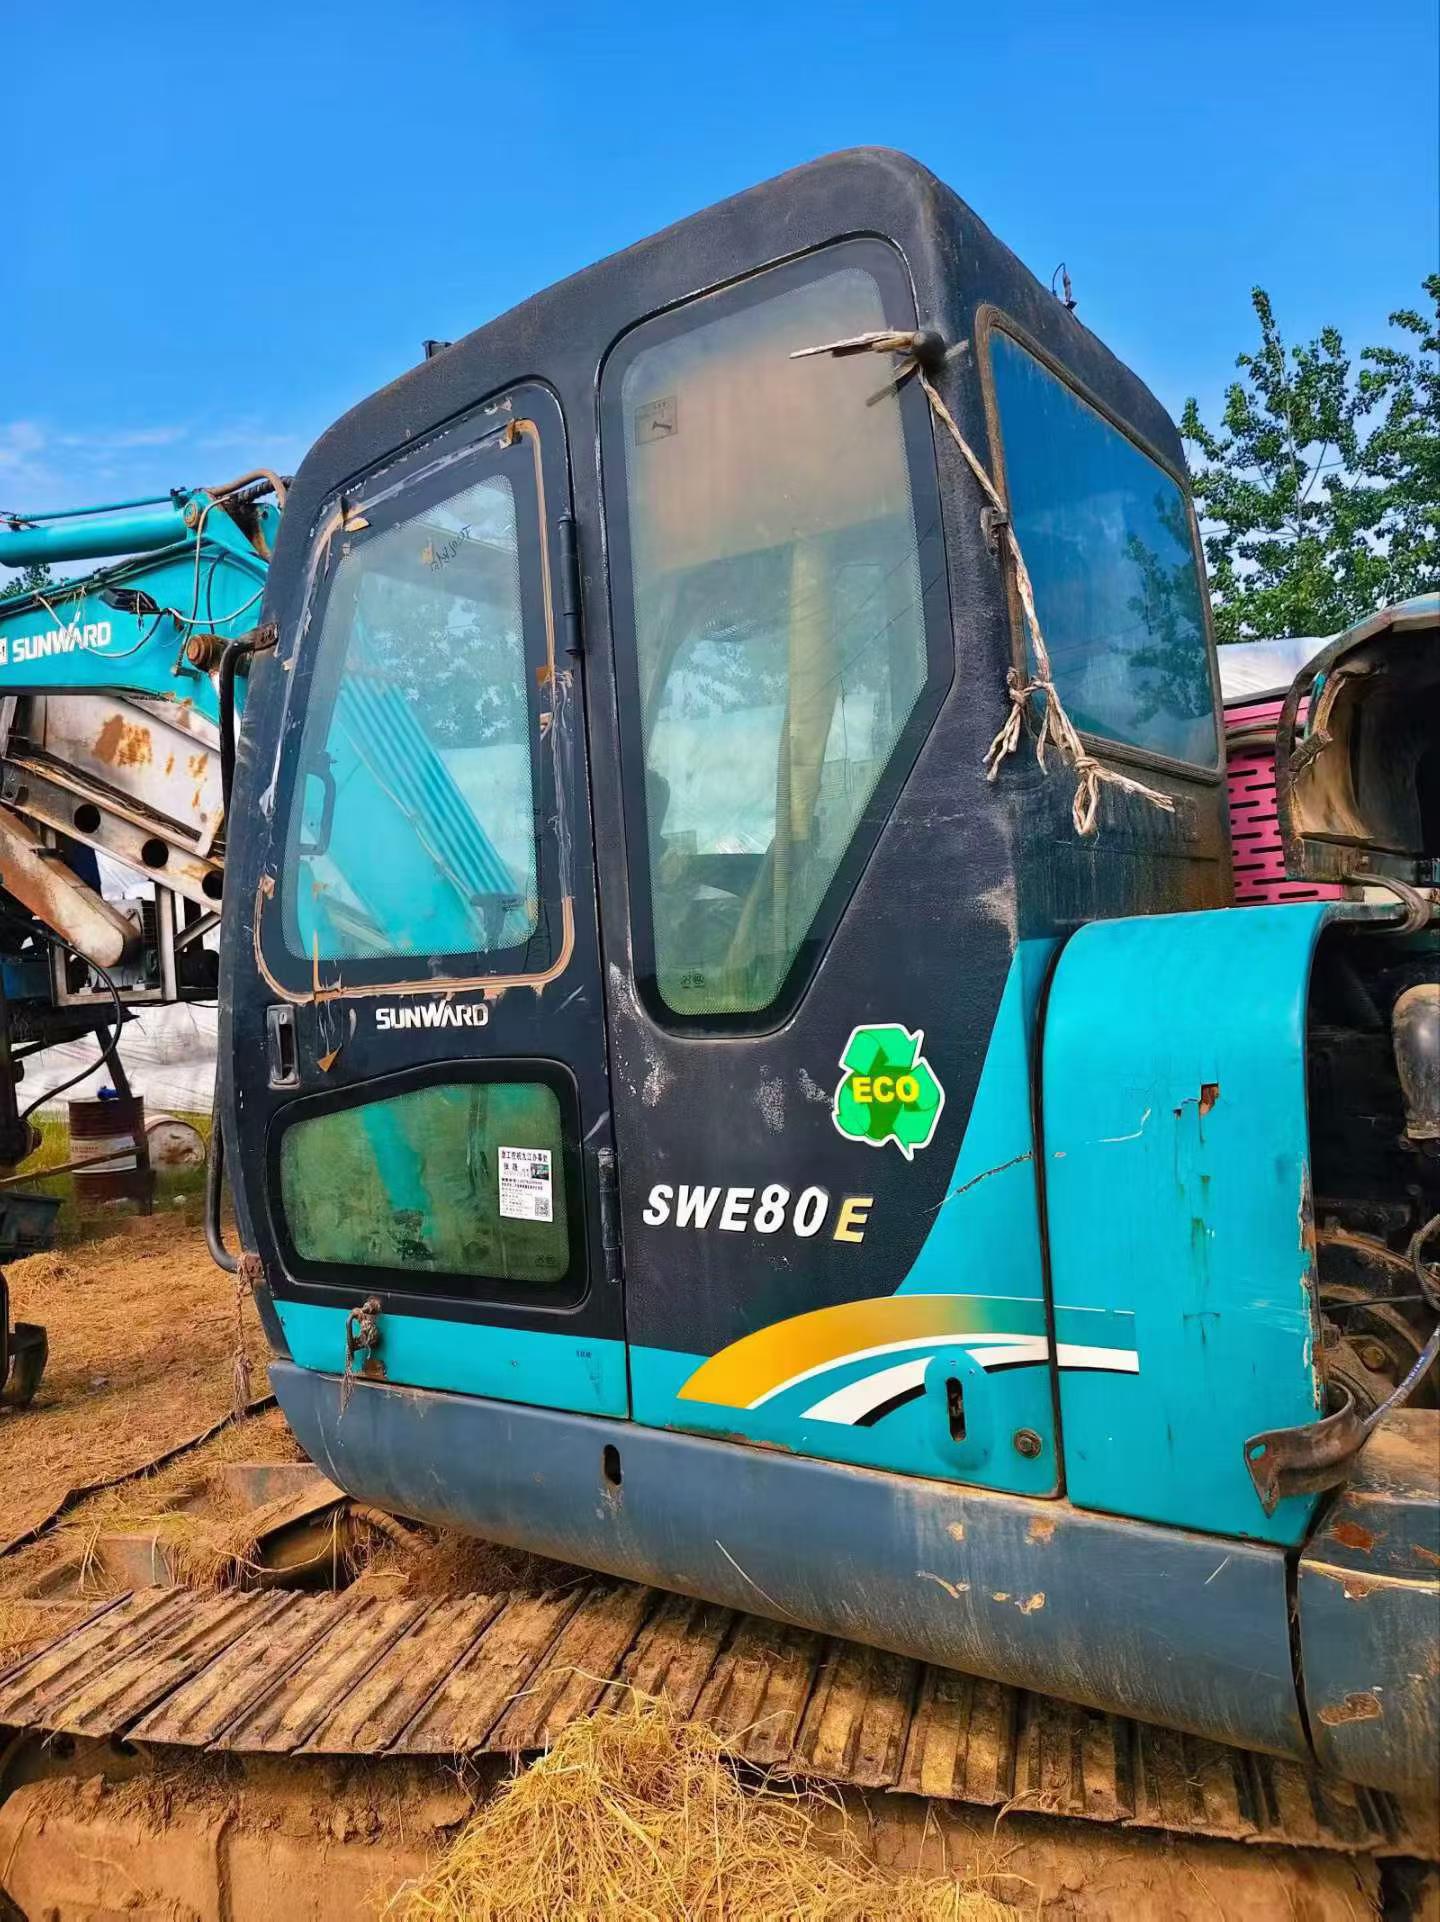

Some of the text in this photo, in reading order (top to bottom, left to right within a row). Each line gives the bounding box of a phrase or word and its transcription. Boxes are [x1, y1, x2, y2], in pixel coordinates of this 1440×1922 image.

[12, 620, 111, 663] SUNWARD
[375, 999, 489, 1029] SUNWARD
[852, 1074, 920, 1103] ECO
